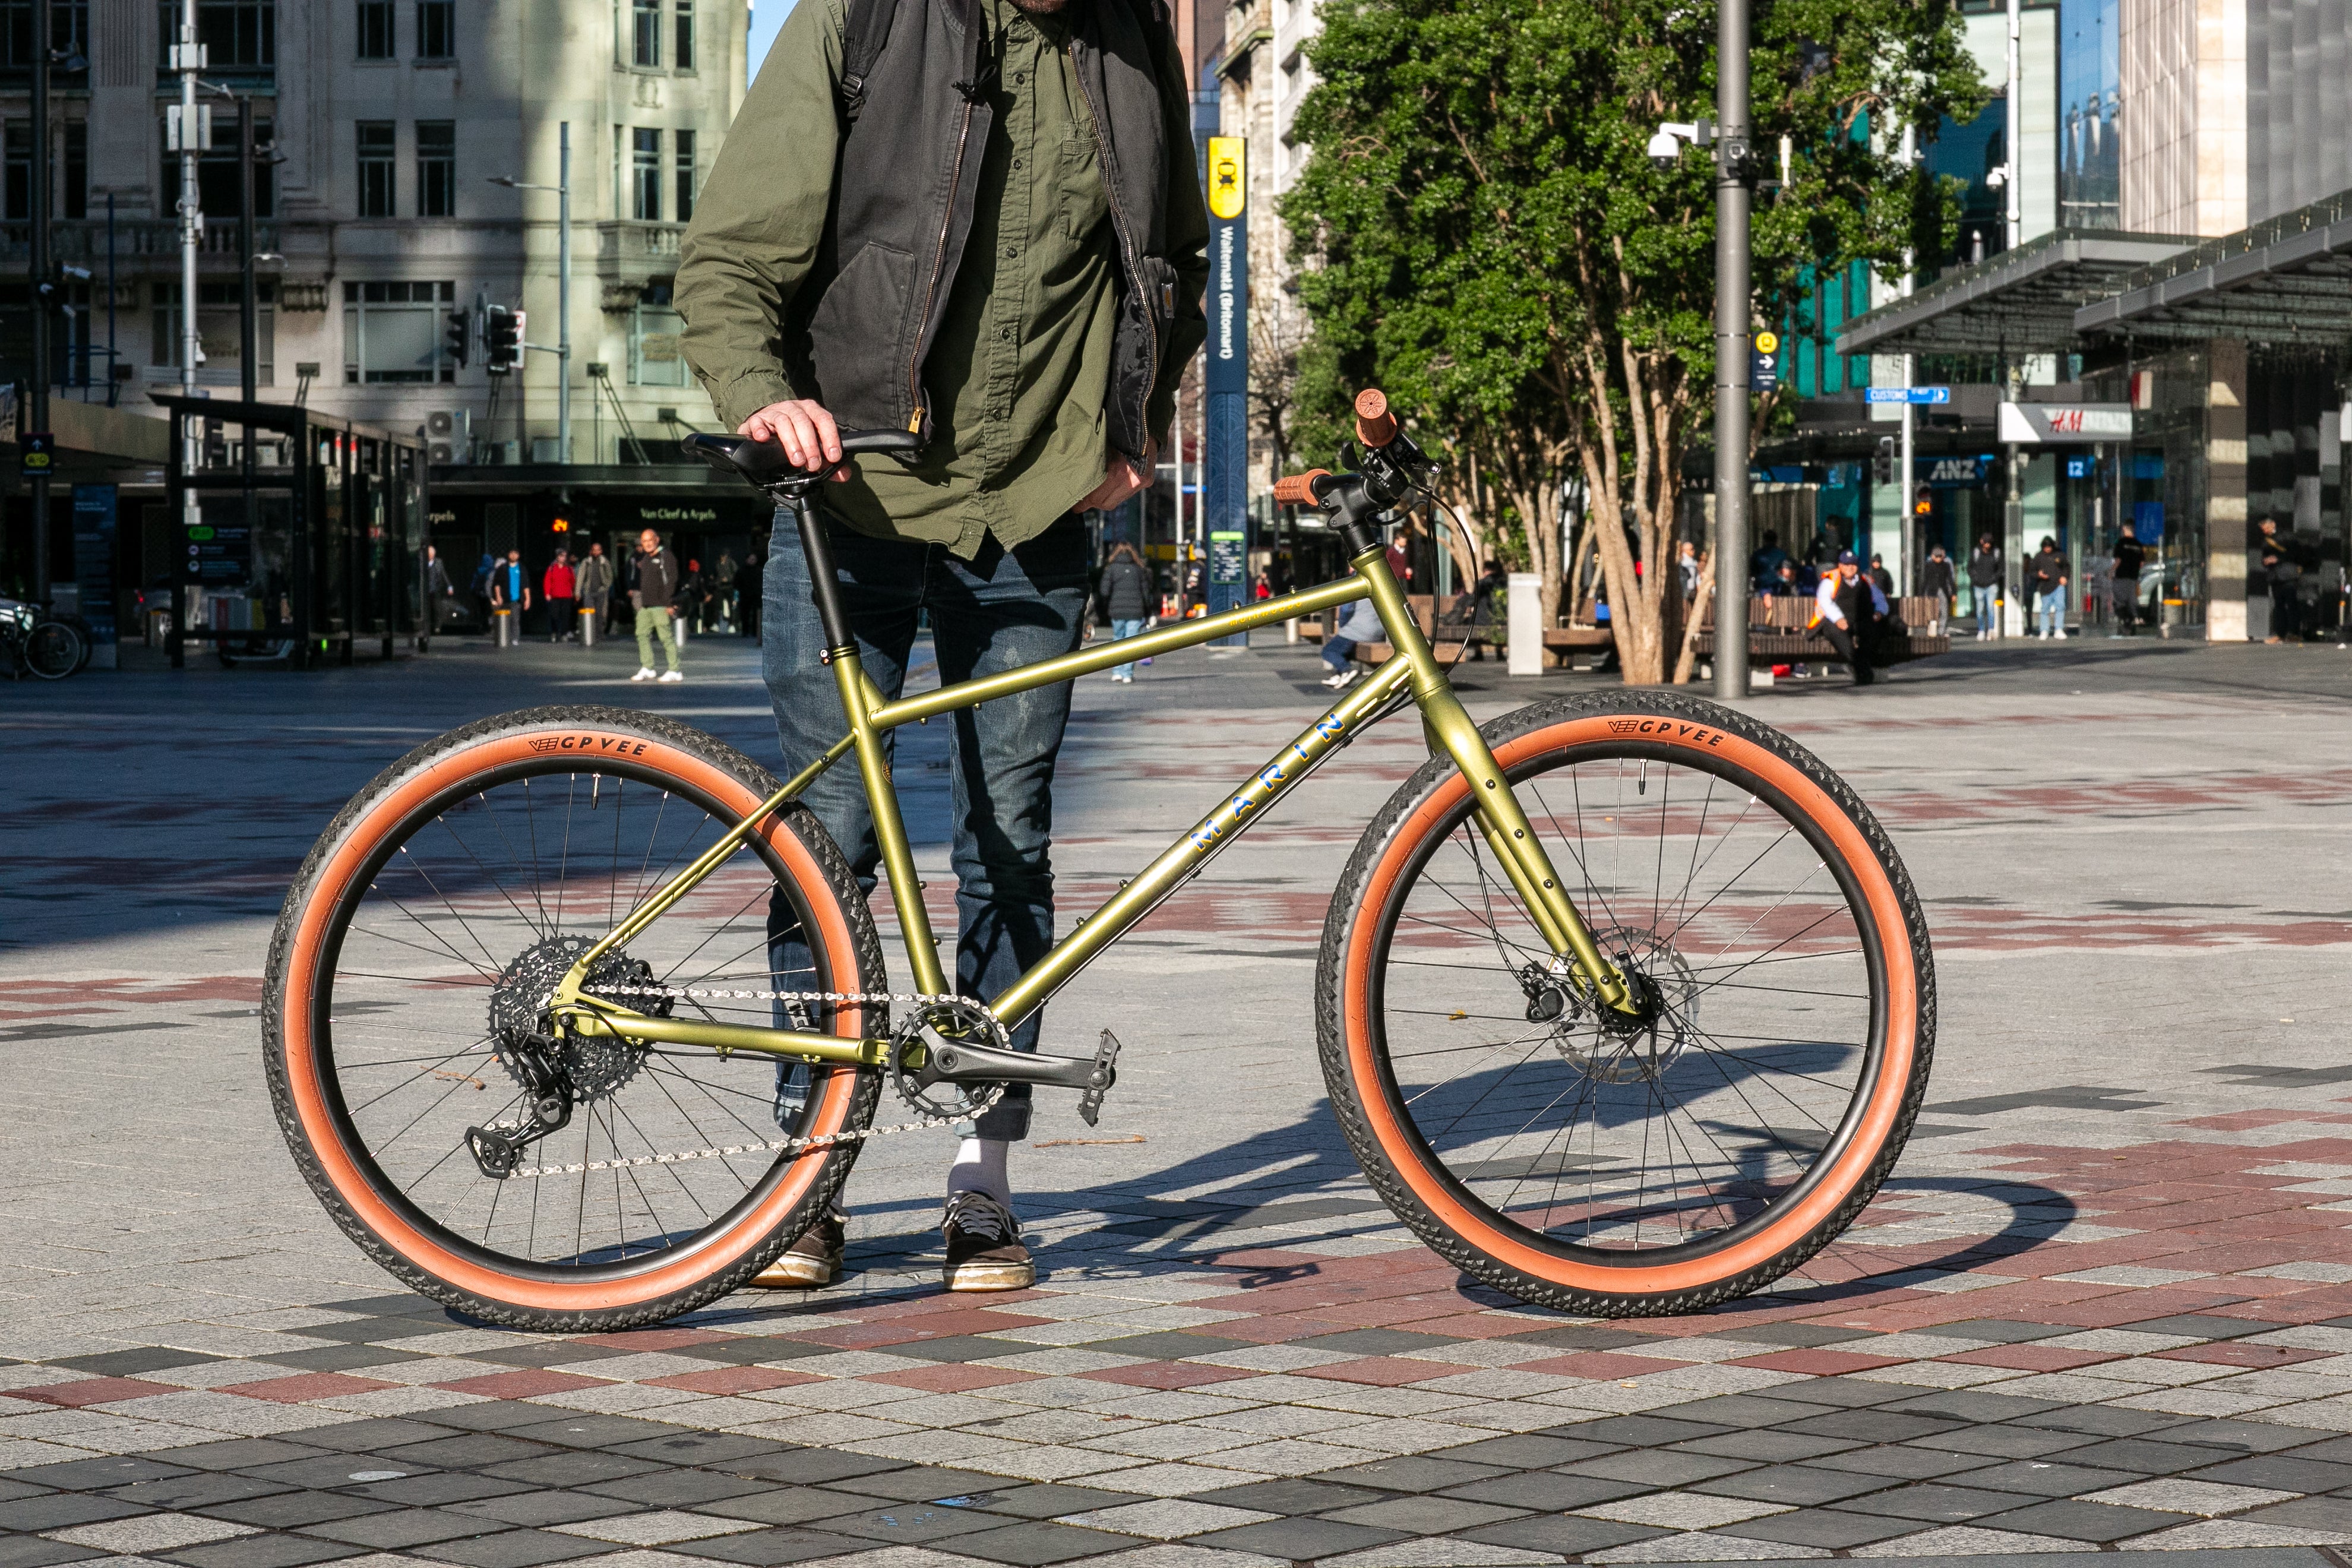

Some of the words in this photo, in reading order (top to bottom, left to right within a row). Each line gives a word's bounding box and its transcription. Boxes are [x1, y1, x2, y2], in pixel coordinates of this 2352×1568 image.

[1219, 292, 1234, 359] (Britomart)
[1930, 459, 1975, 480] ANZ
[429, 510, 456, 524] rpels
[640, 508, 657, 520] Van
[657, 508, 681, 520] Cleef
[682, 510, 688, 520] &
[690, 508, 717, 522] Arpels
[1190, 712, 1345, 852] MARIN
